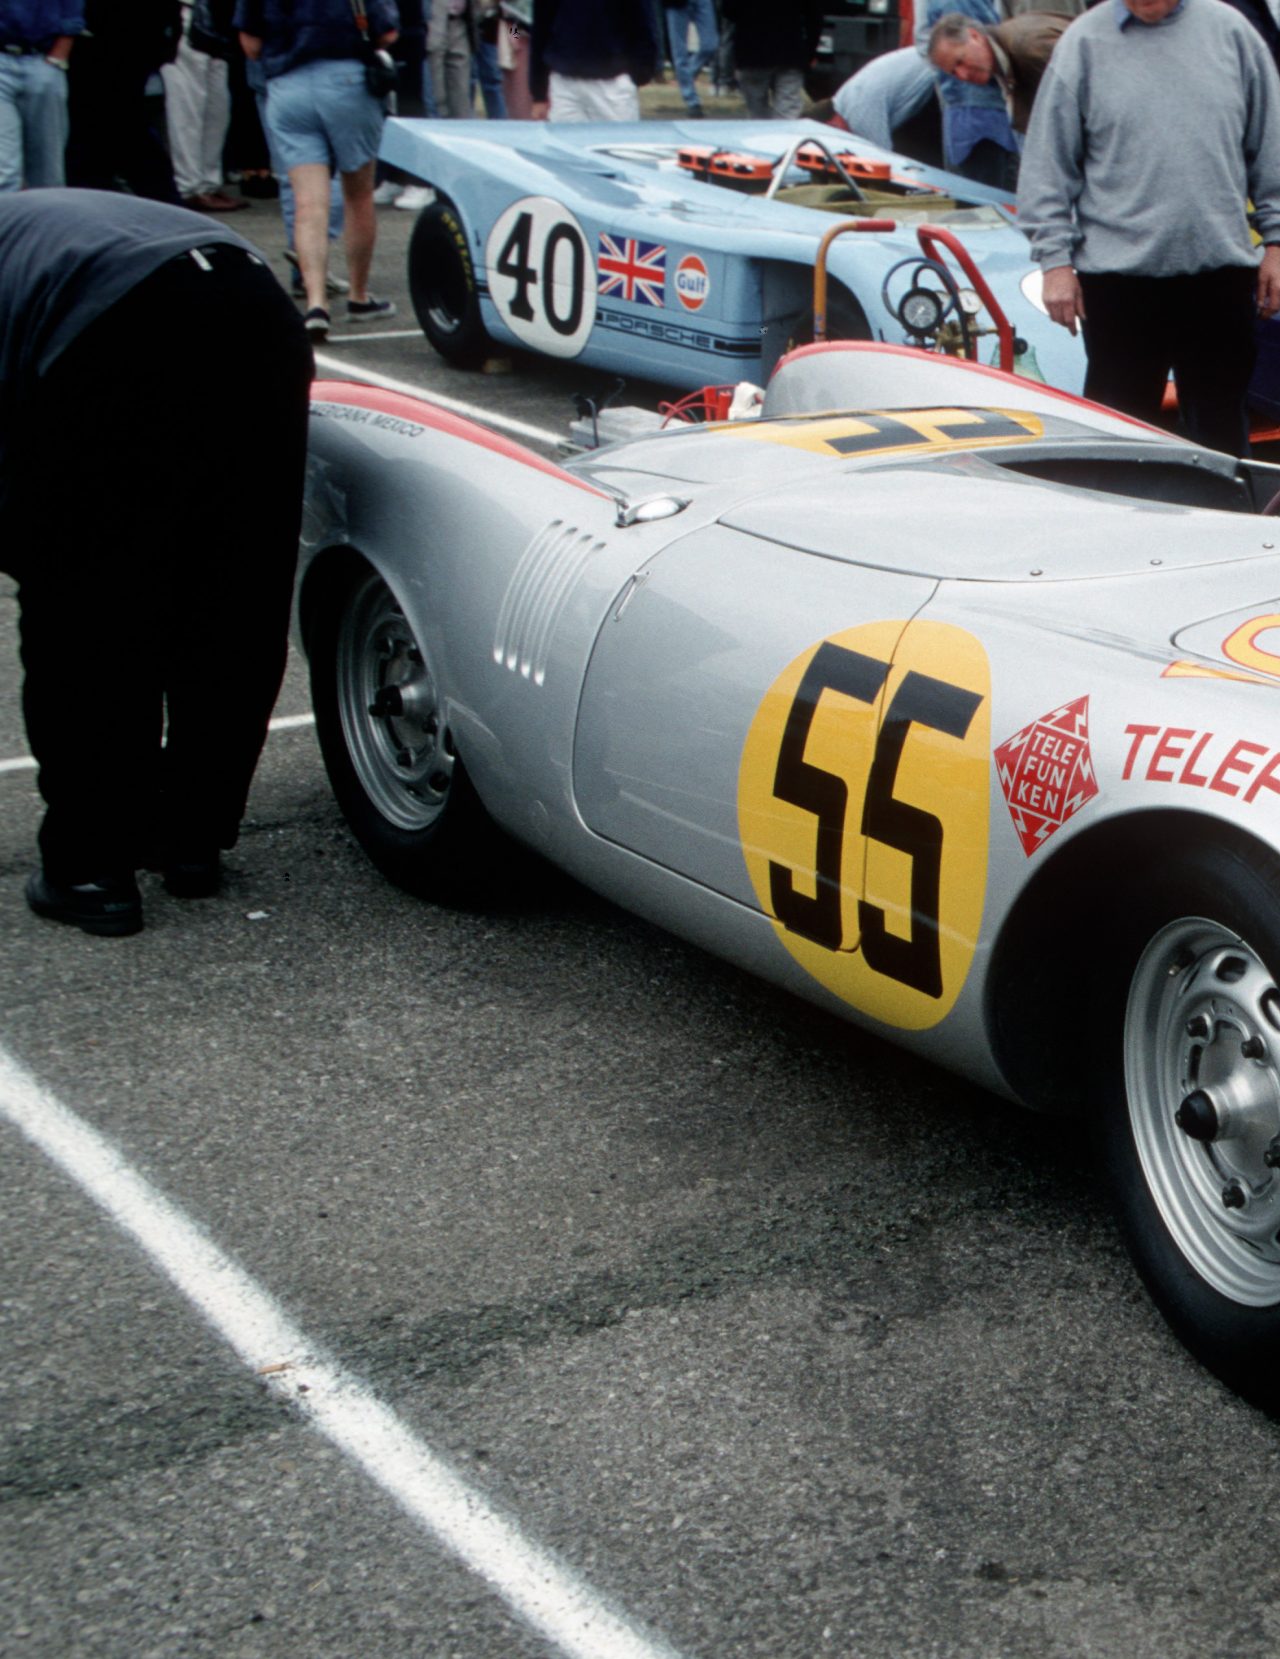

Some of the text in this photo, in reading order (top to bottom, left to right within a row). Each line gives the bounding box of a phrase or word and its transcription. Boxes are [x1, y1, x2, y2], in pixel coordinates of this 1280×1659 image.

[496, 211, 585, 336] 40
[676, 272, 706, 294] Gulf
[605, 313, 712, 349] PORSCHE
[1032, 731, 1076, 765] TELE
[1024, 755, 1067, 790] FUN
[1017, 779, 1059, 815] KEN
[769, 638, 984, 999] 55
